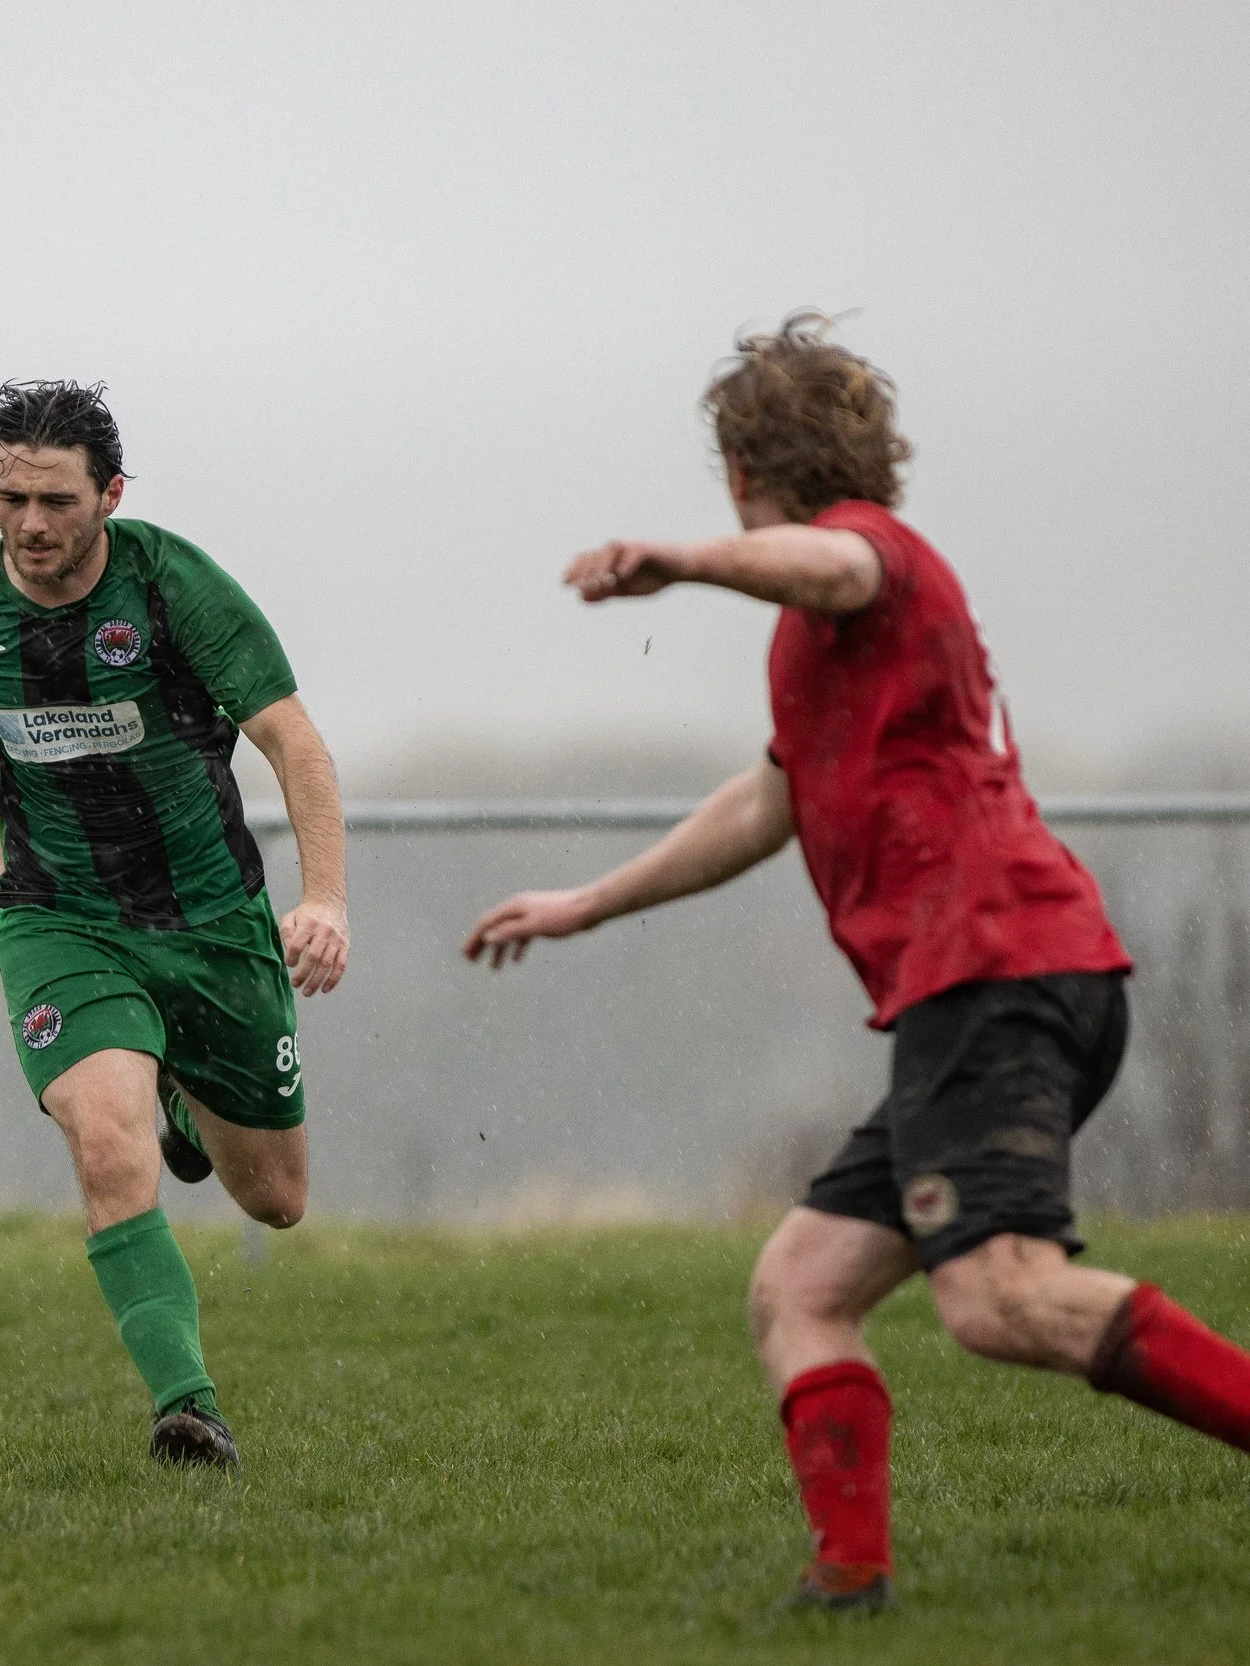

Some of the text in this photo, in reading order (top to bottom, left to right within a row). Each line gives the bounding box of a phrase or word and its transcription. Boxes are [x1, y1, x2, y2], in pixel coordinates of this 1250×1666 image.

[23, 709, 114, 728] Lakeland
[27, 720, 139, 744] Verandahs
[44, 742, 87, 756] FENCING
